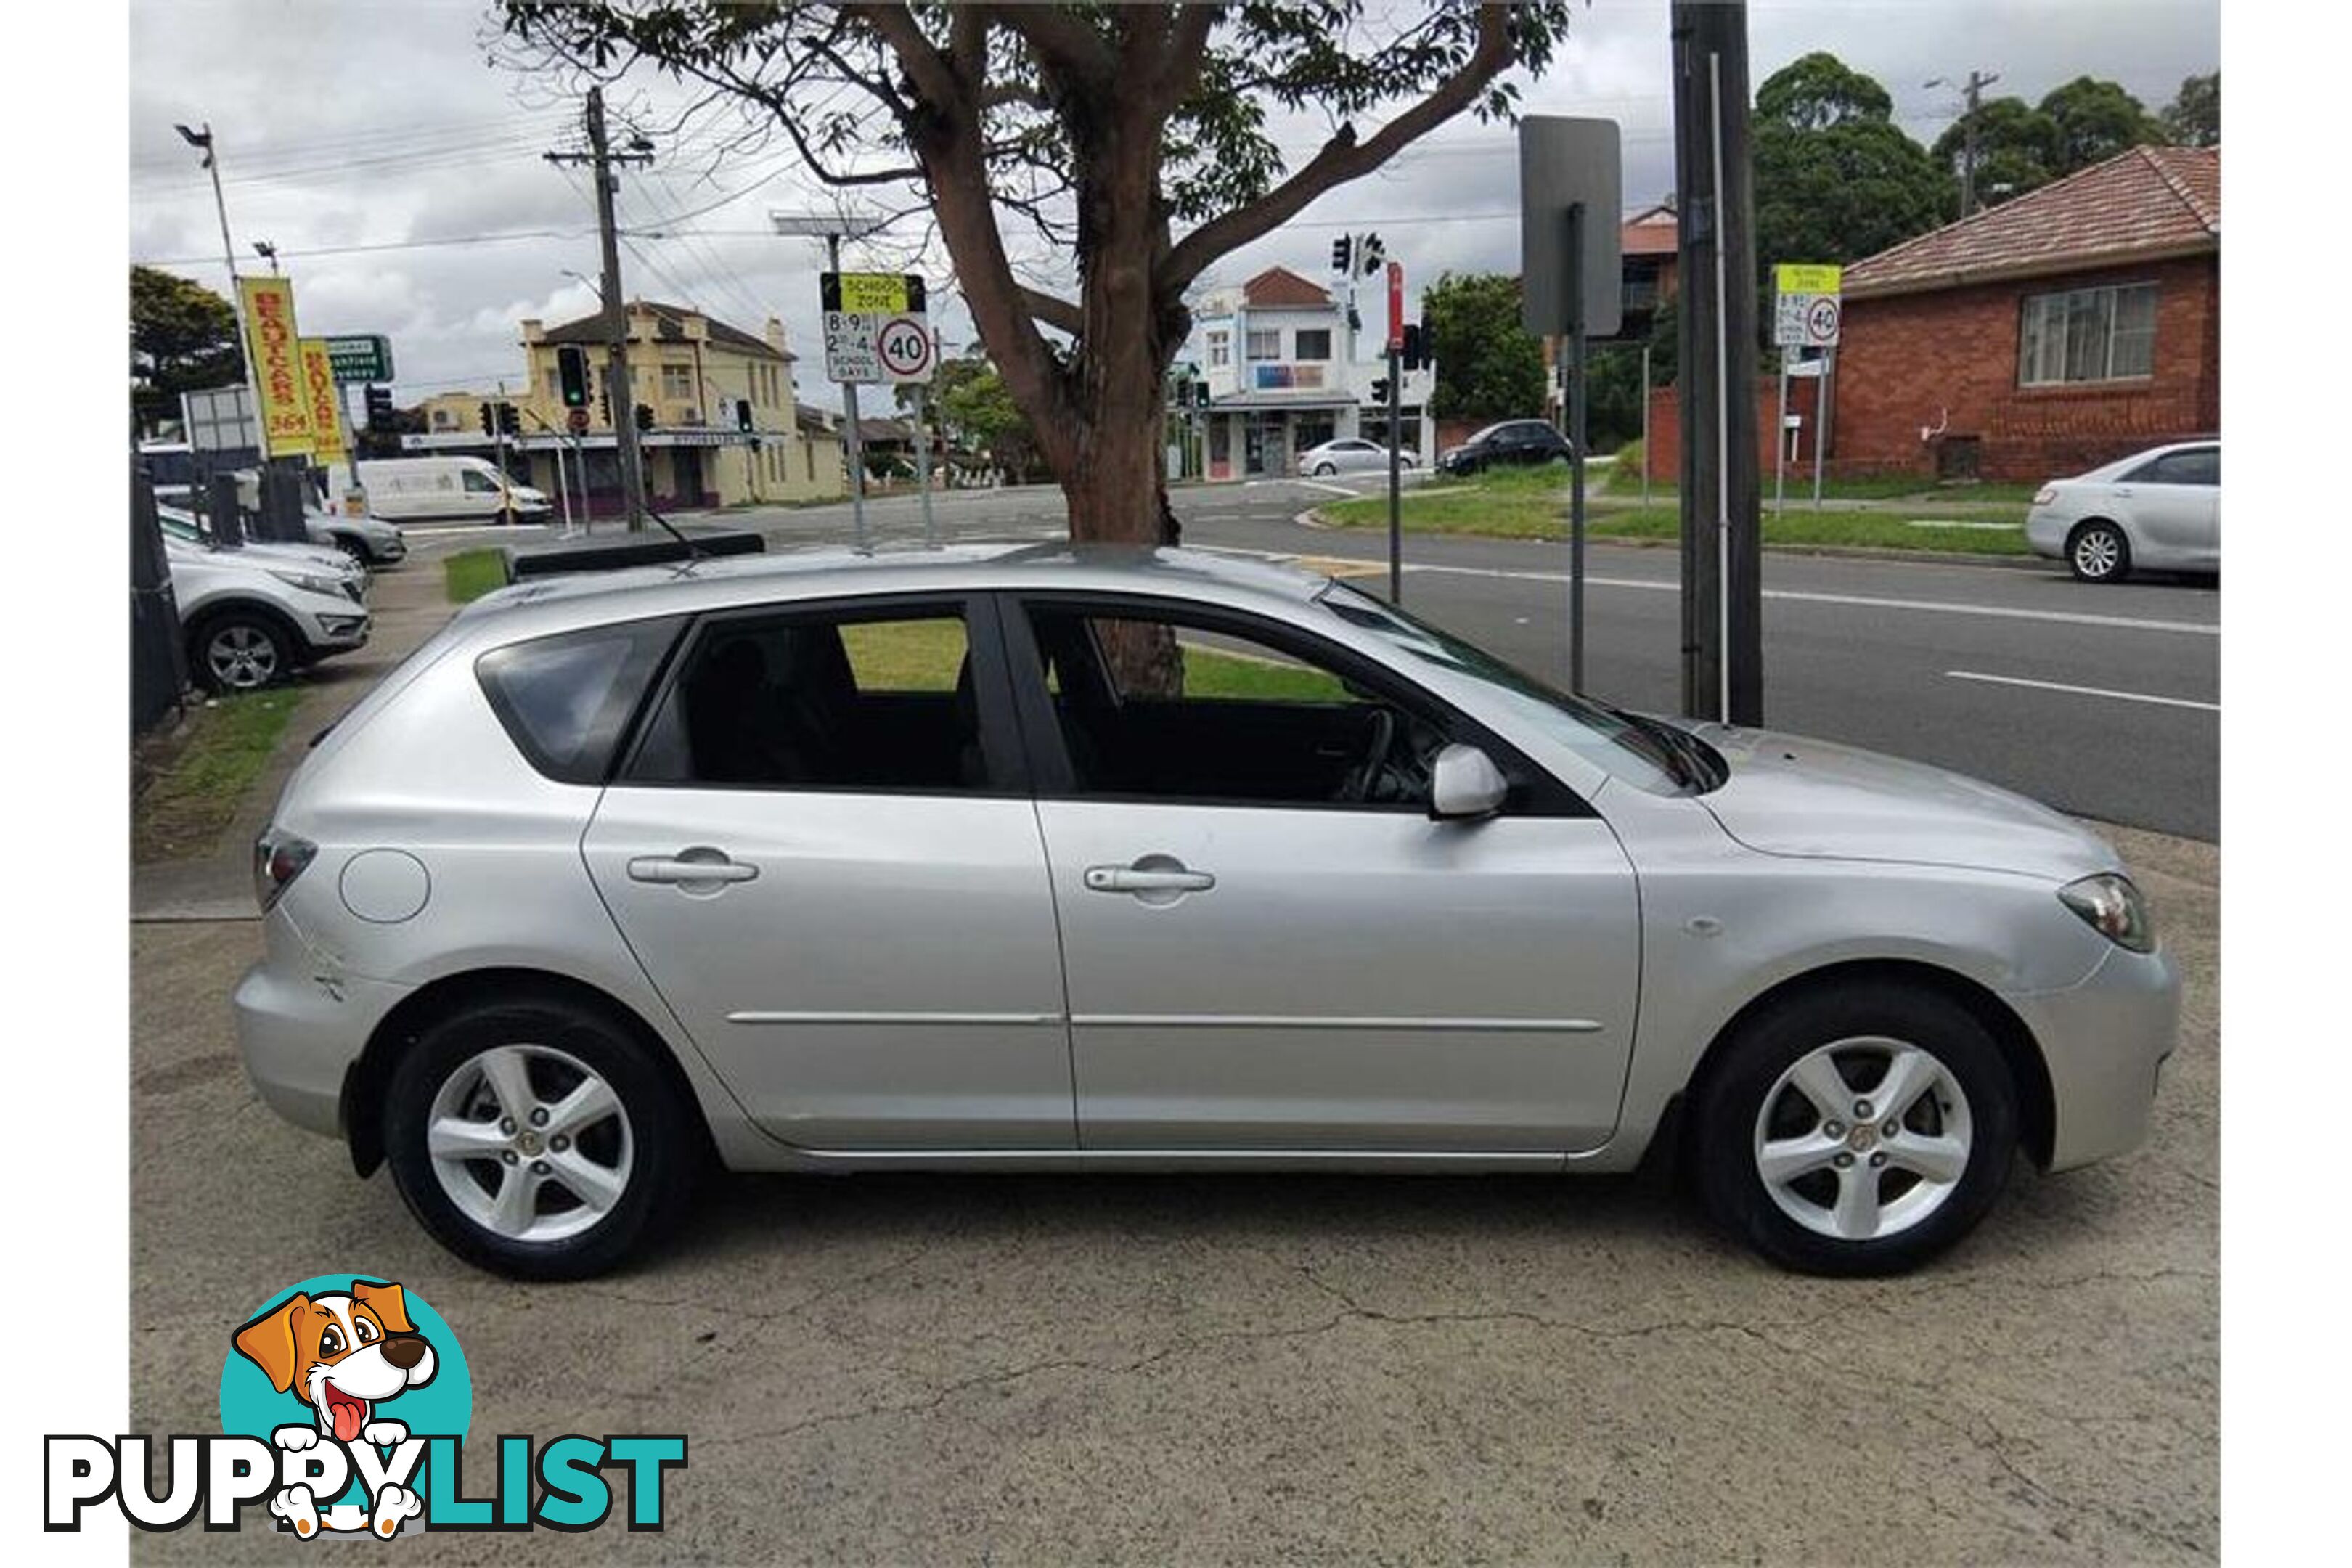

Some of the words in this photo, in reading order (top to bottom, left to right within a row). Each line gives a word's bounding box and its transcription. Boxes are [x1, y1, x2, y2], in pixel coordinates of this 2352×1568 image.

[846, 279, 902, 293] SCHOOL
[857, 295, 890, 308] ZONE
[888, 335, 923, 360] 40
[834, 355, 875, 365] SCHOOL
